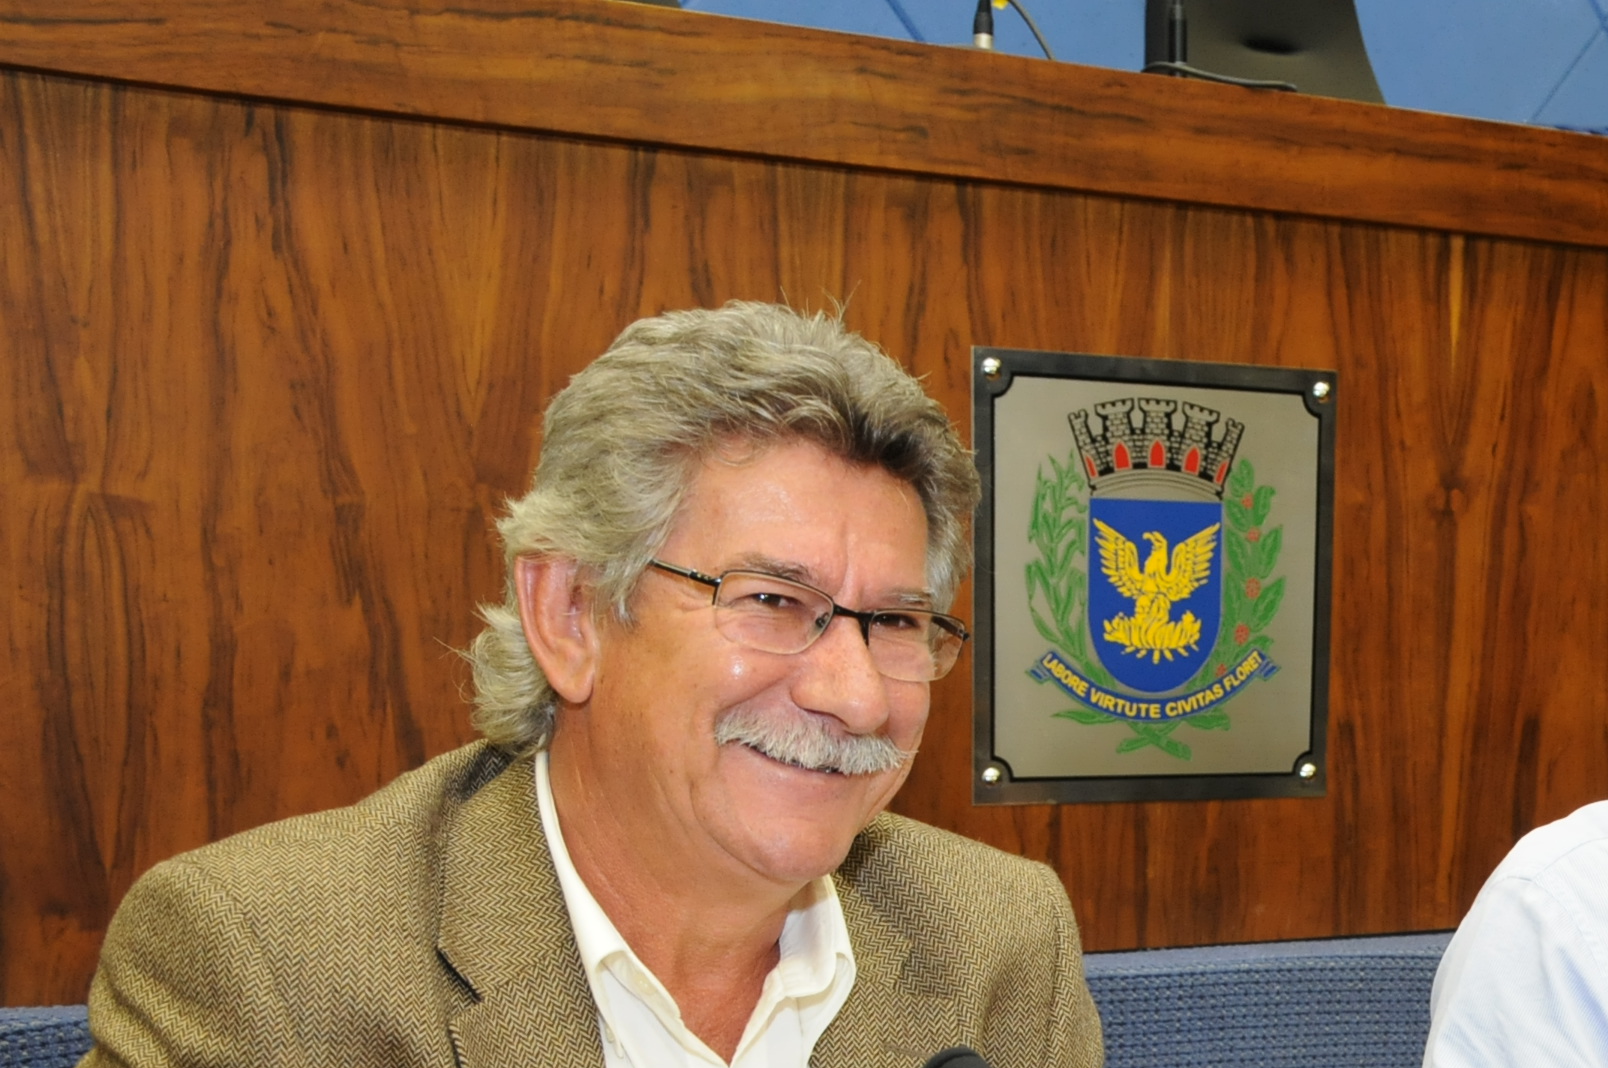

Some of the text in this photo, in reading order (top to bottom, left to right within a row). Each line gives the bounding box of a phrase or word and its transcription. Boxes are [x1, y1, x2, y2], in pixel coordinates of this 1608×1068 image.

[1042, 650, 1263, 718] LABORE VIRTUTE CIVITAS FLORET
